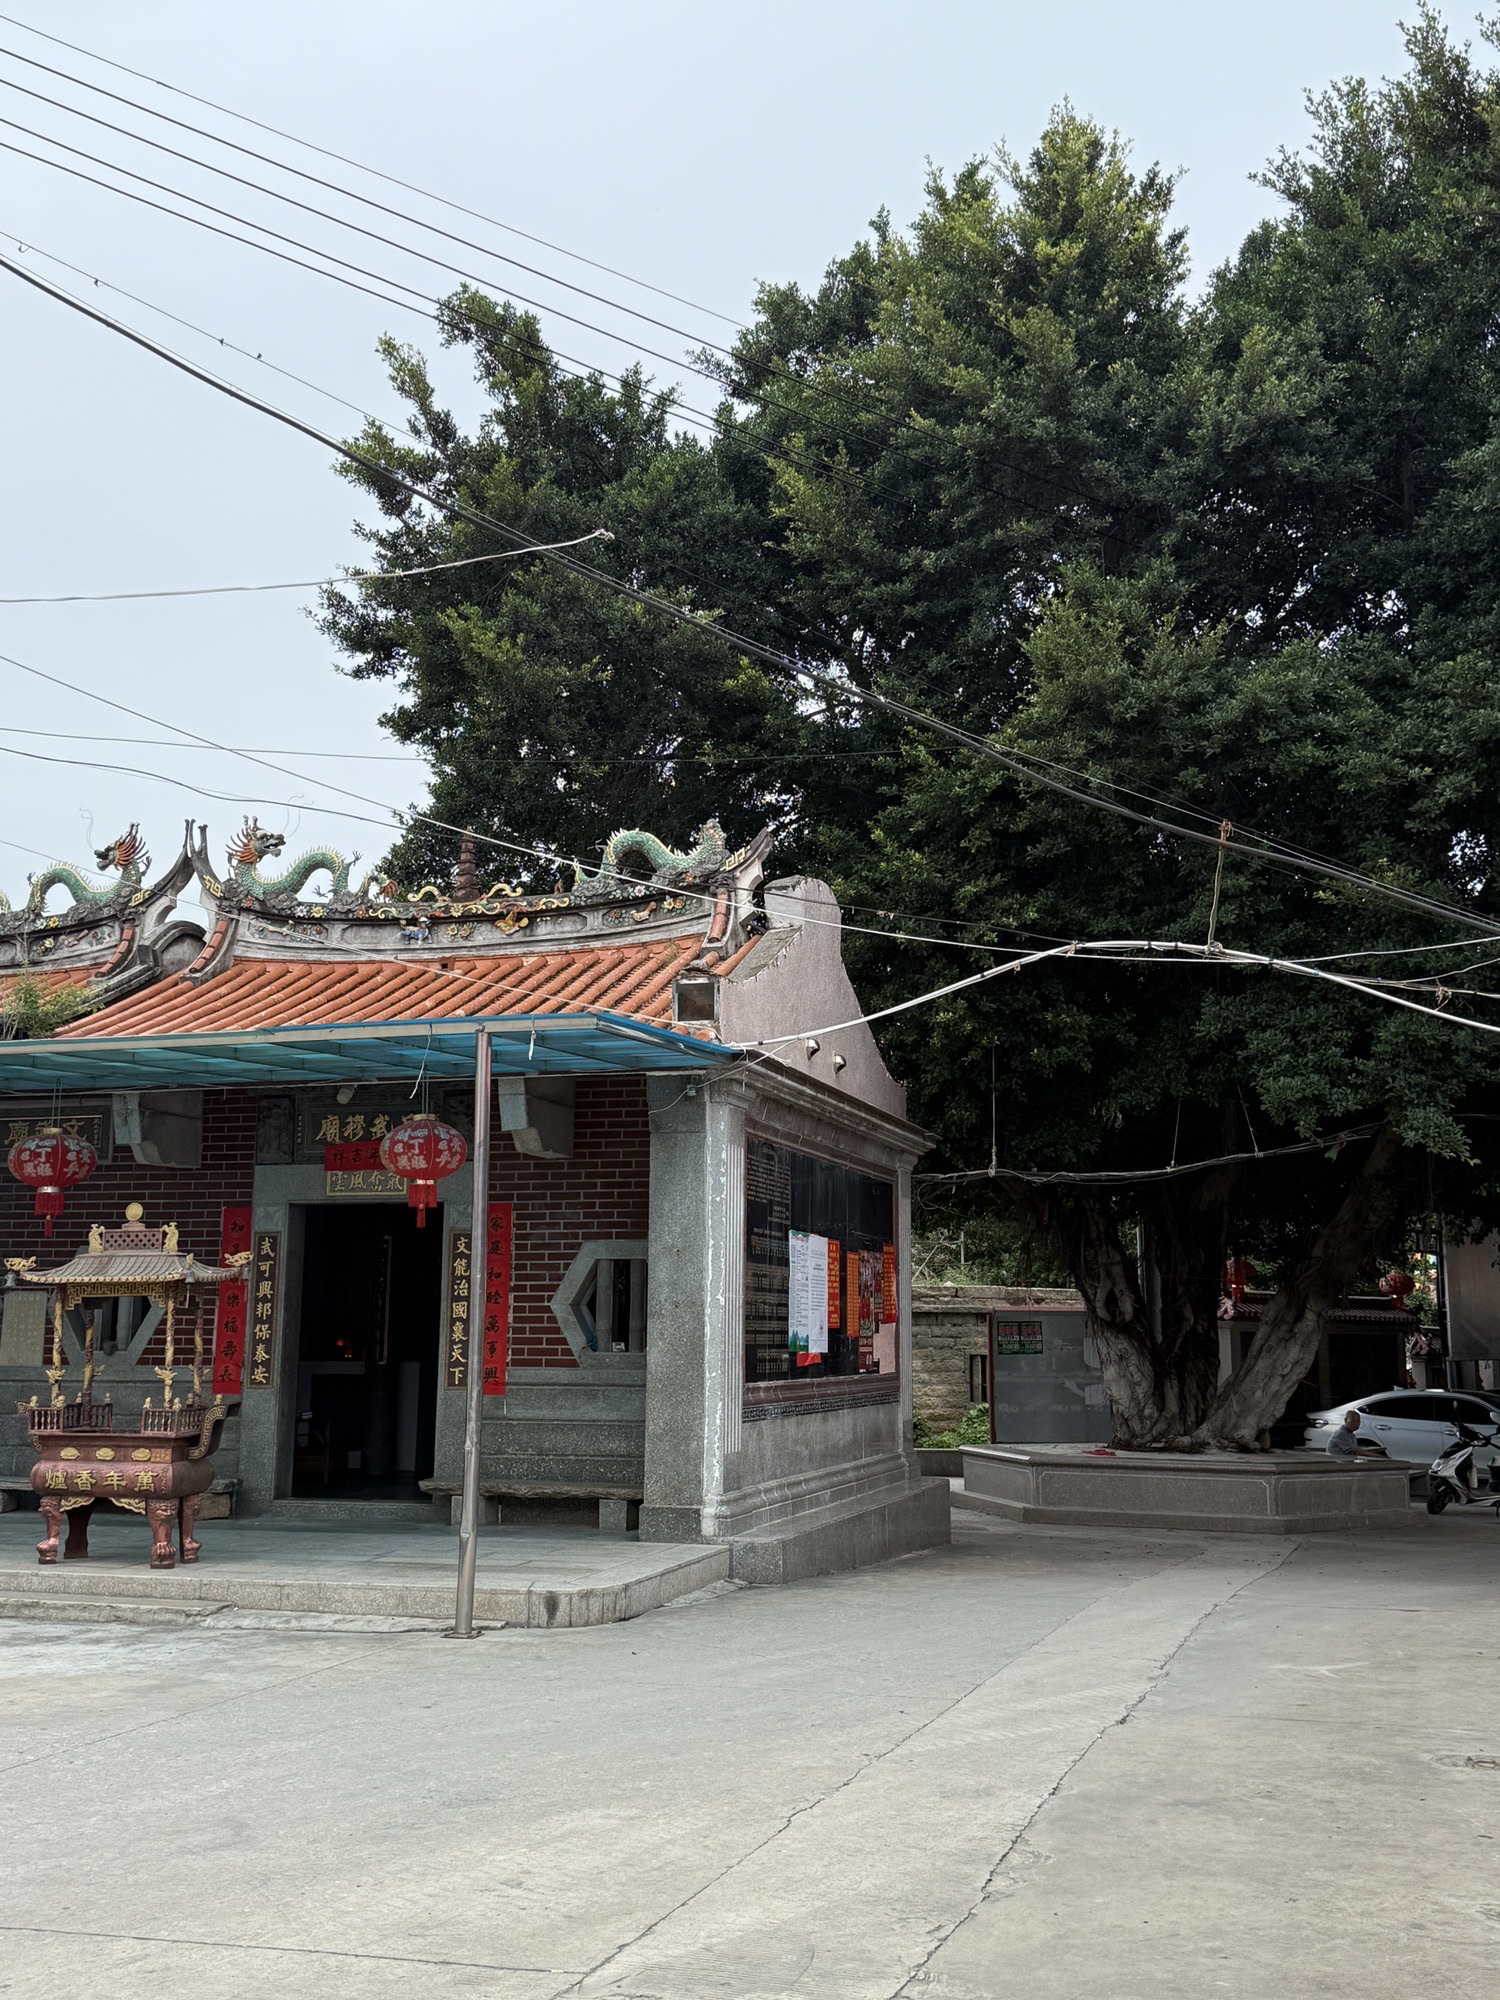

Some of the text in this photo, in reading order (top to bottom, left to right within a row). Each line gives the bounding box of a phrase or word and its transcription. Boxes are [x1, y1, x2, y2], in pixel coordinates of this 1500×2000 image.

[315, 1113, 413, 1144] 武穆廟
[332, 1147, 380, 1168] 年吉祥
[219, 1219, 245, 1383] 知足樂福壽長
[251, 1237, 275, 1384] 武可興邦保泰安
[484, 1215, 504, 1386] 家庭和睦萬事興
[45, 1469, 159, 1492] 萬年香爐
